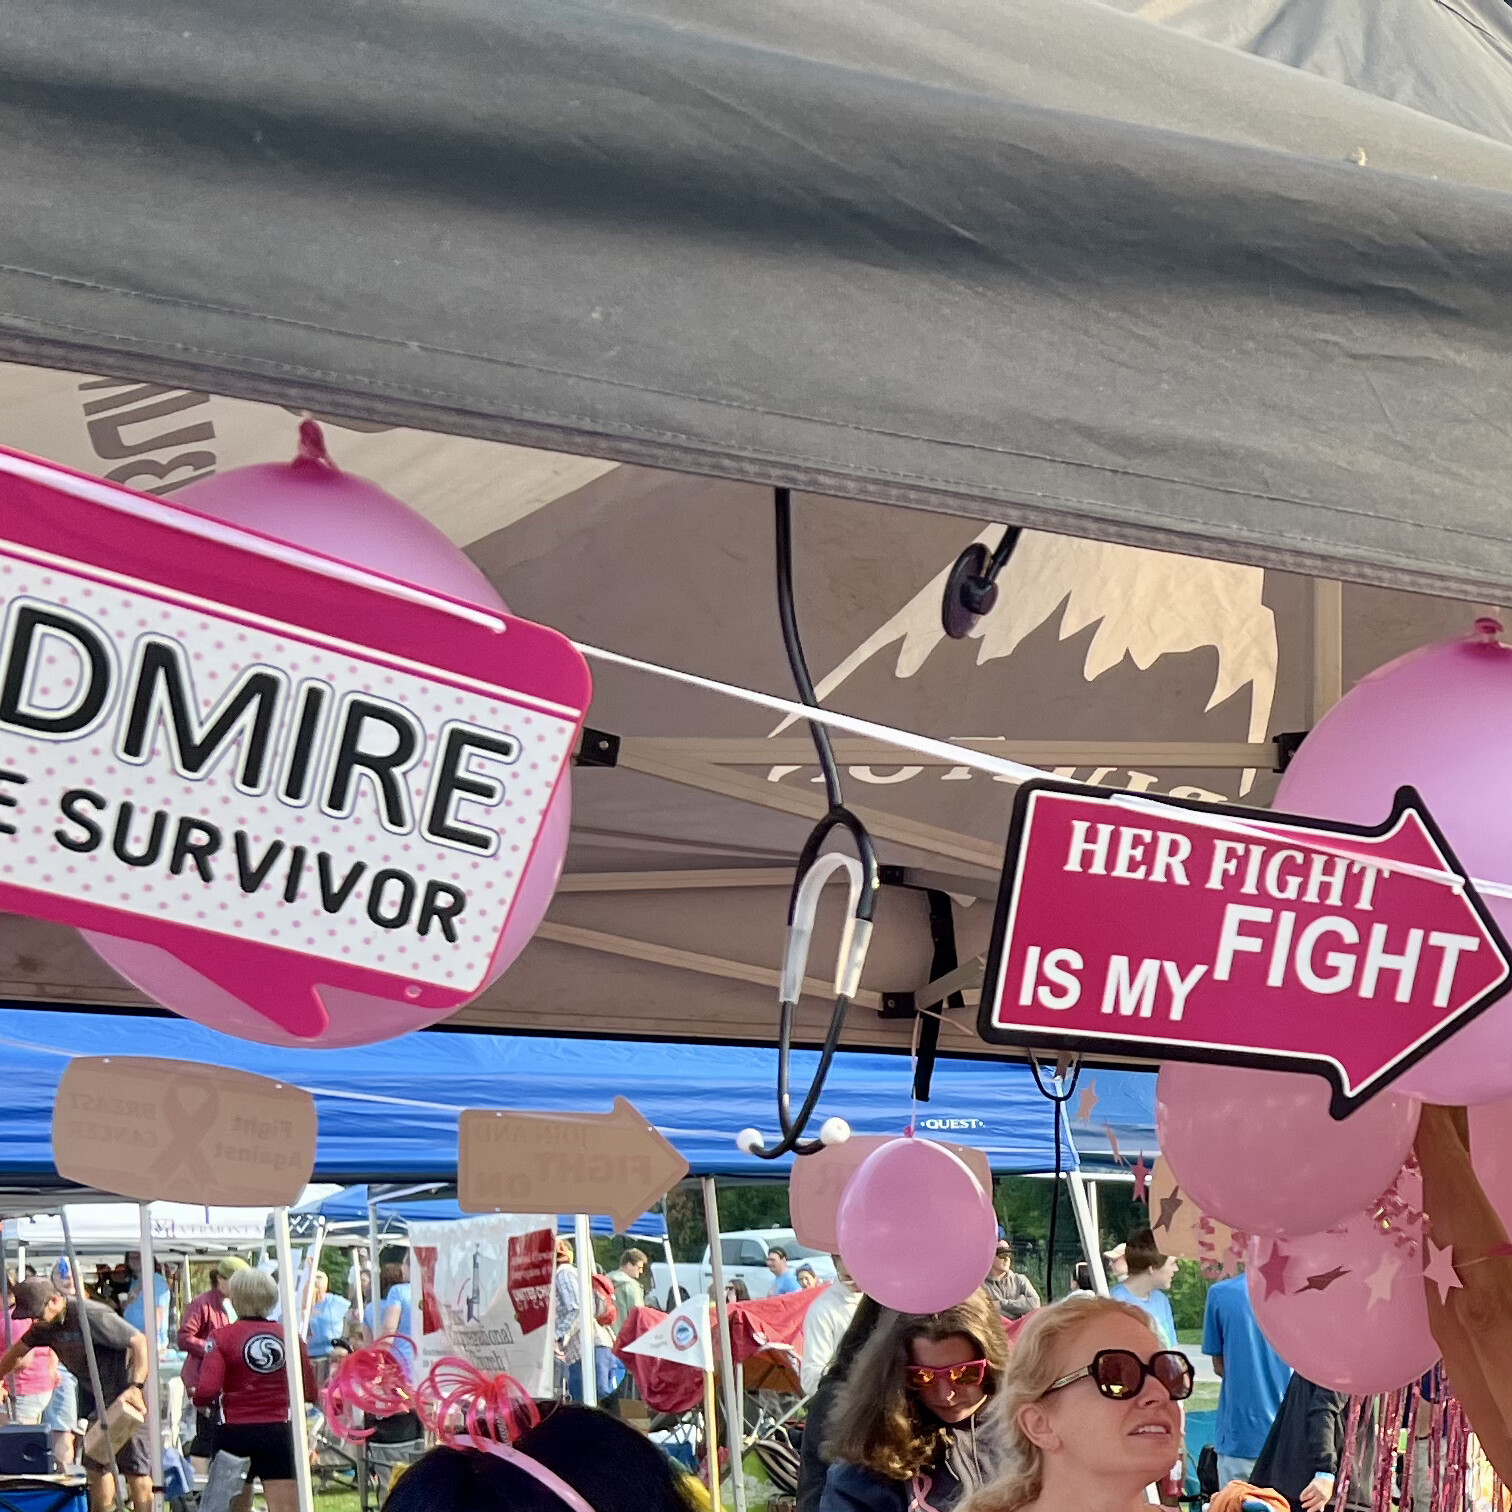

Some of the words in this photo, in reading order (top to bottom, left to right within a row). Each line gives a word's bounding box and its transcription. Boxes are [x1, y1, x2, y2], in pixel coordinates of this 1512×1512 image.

[54, 788, 467, 944] SURVIVOR
[1063, 819, 1191, 887] HER
[1204, 838, 1390, 911] FIGHT
[1018, 945, 1084, 1011] IS
[1101, 954, 1209, 1022] MY
[1212, 902, 1481, 1009] FIGHT
[925, 1118, 980, 1131] QUEST
